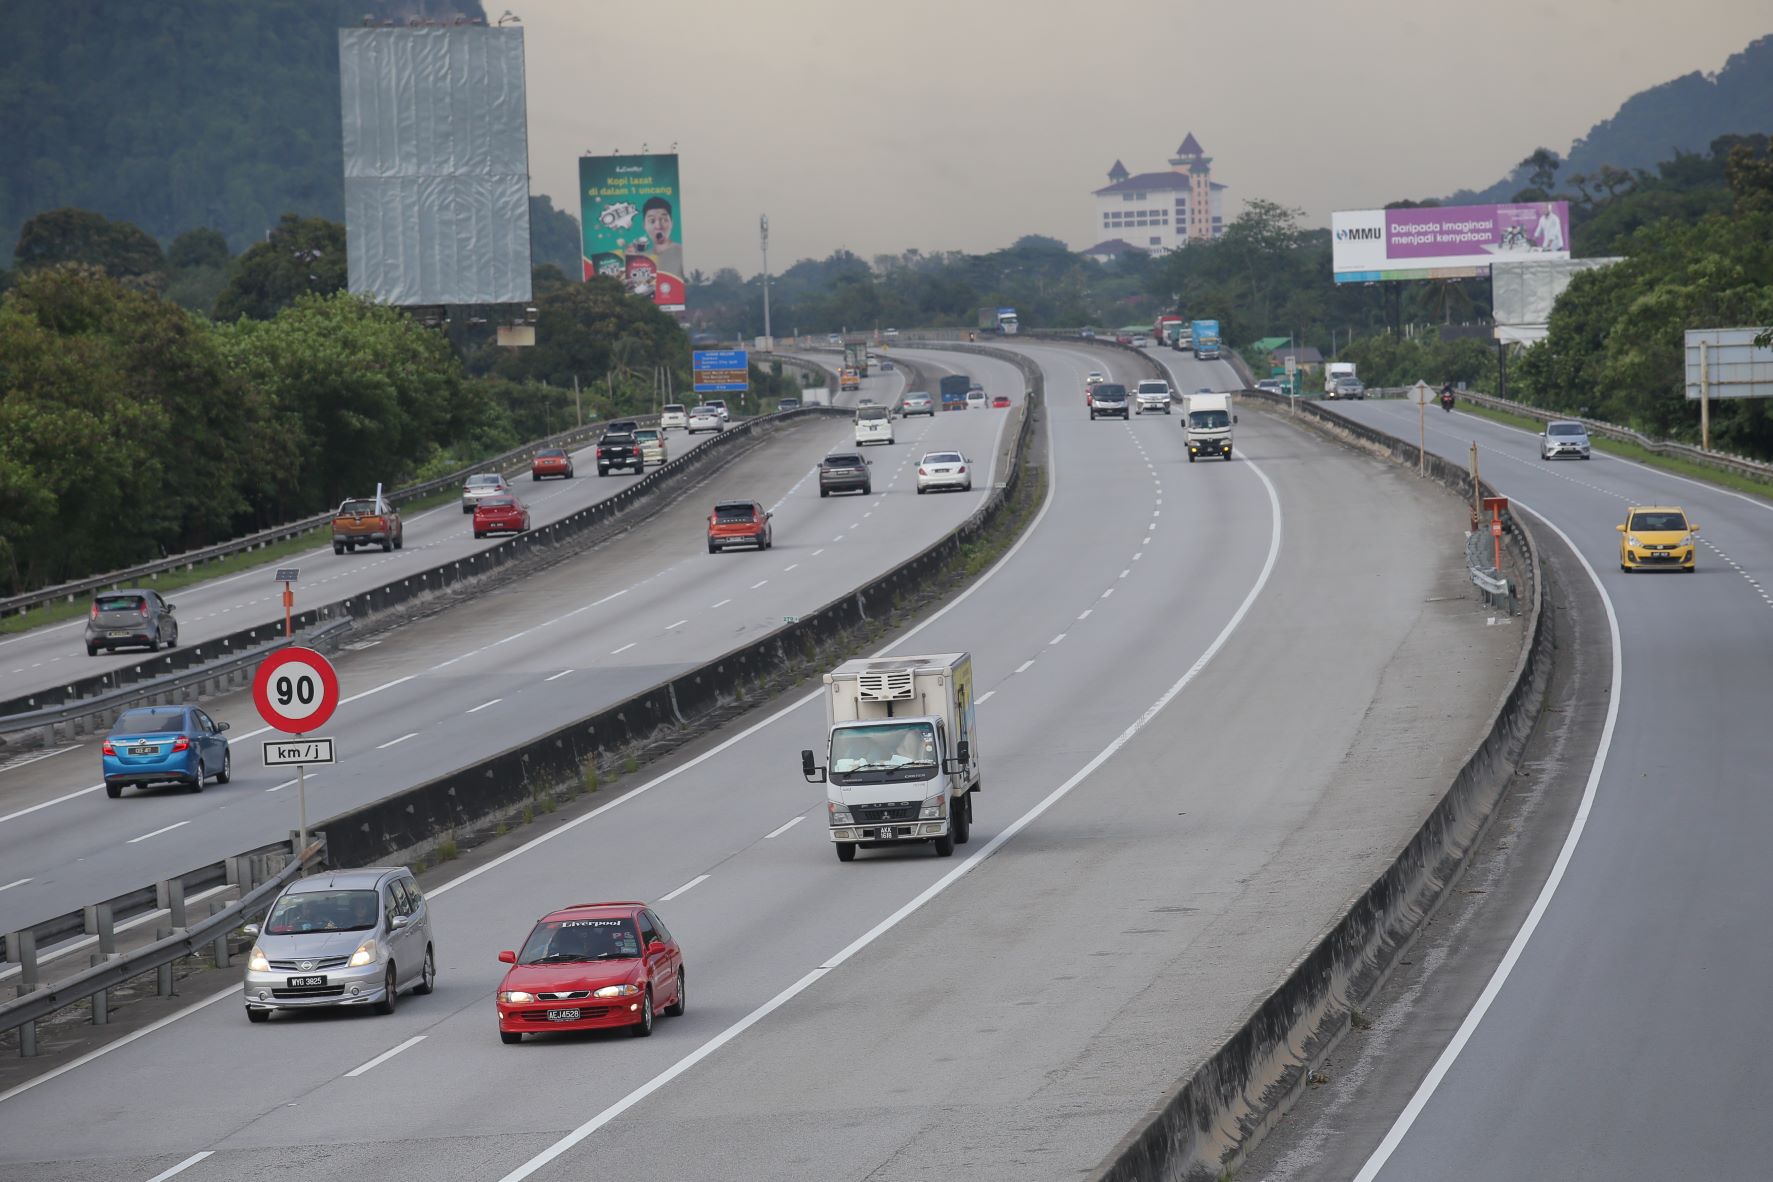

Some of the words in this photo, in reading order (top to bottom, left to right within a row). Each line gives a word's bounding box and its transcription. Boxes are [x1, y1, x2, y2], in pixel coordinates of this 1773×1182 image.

[607, 177, 628, 186] Kopi
[630, 176, 653, 185] lazat
[588, 187, 598, 196] di
[600, 187, 628, 195] dalam
[639, 186, 672, 196] uncang
[1391, 223, 1440, 234] Daripada
[1443, 220, 1493, 233] imaginasi
[1348, 228, 1381, 241] MMU
[1391, 233, 1434, 246] menjadi
[1437, 231, 1492, 243] kenyataan
[276, 675, 314, 706] 90
[561, 920, 622, 928] Liverpool
